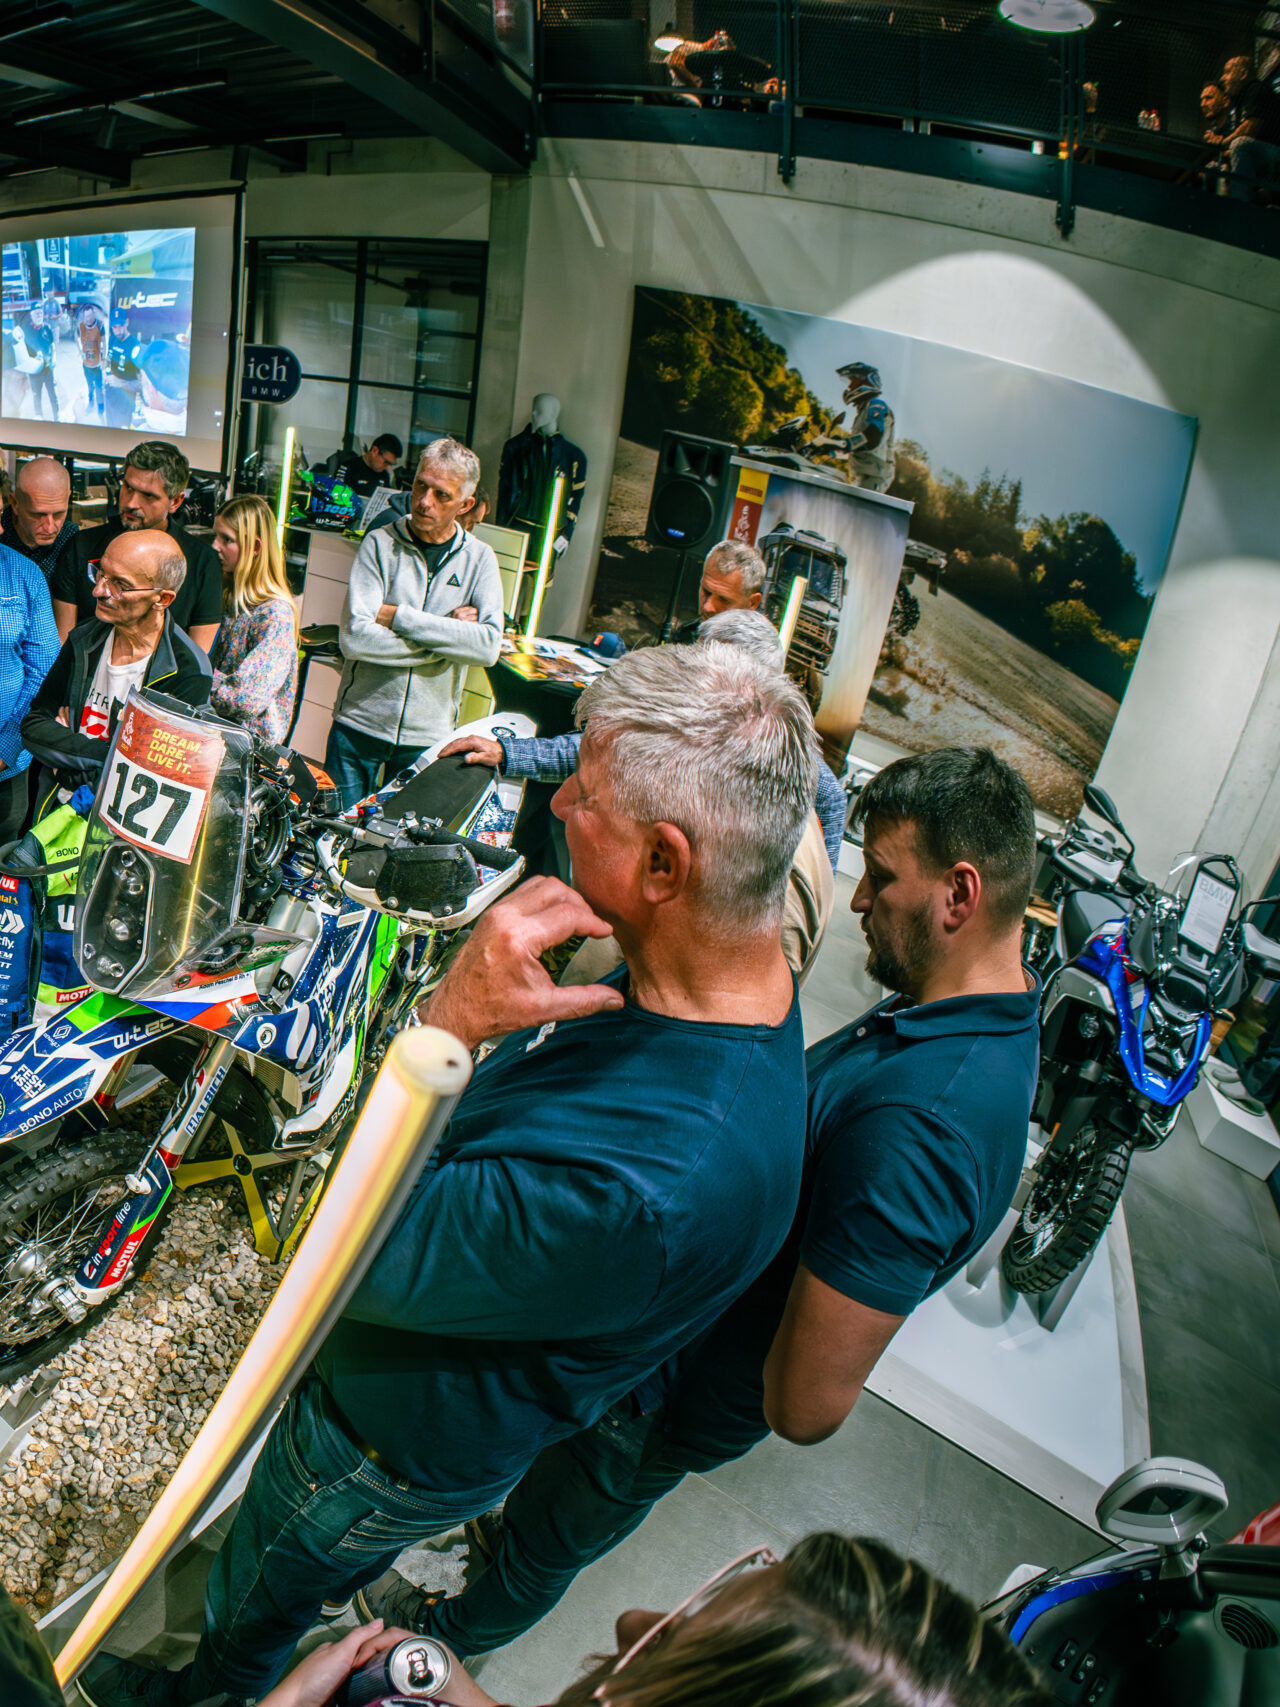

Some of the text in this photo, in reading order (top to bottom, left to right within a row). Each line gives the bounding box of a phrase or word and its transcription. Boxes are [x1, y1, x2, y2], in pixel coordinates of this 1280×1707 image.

[118, 291, 178, 310] w-tec
[252, 386, 280, 397] BMW
[324, 504, 356, 517] 100%
[149, 740, 187, 761] DARE.
[152, 728, 202, 753] DREAM.
[147, 751, 192, 775] LIVE IT.
[106, 762, 192, 846] 127
[56, 846, 79, 858] BONO
[1199, 878, 1234, 905] BMW
[113, 1016, 175, 1050] w-tec
[19, 1088, 83, 1133] BONO AUTO
[184, 1066, 226, 1137] HALBICH
[111, 1240, 139, 1279] MOTUL
